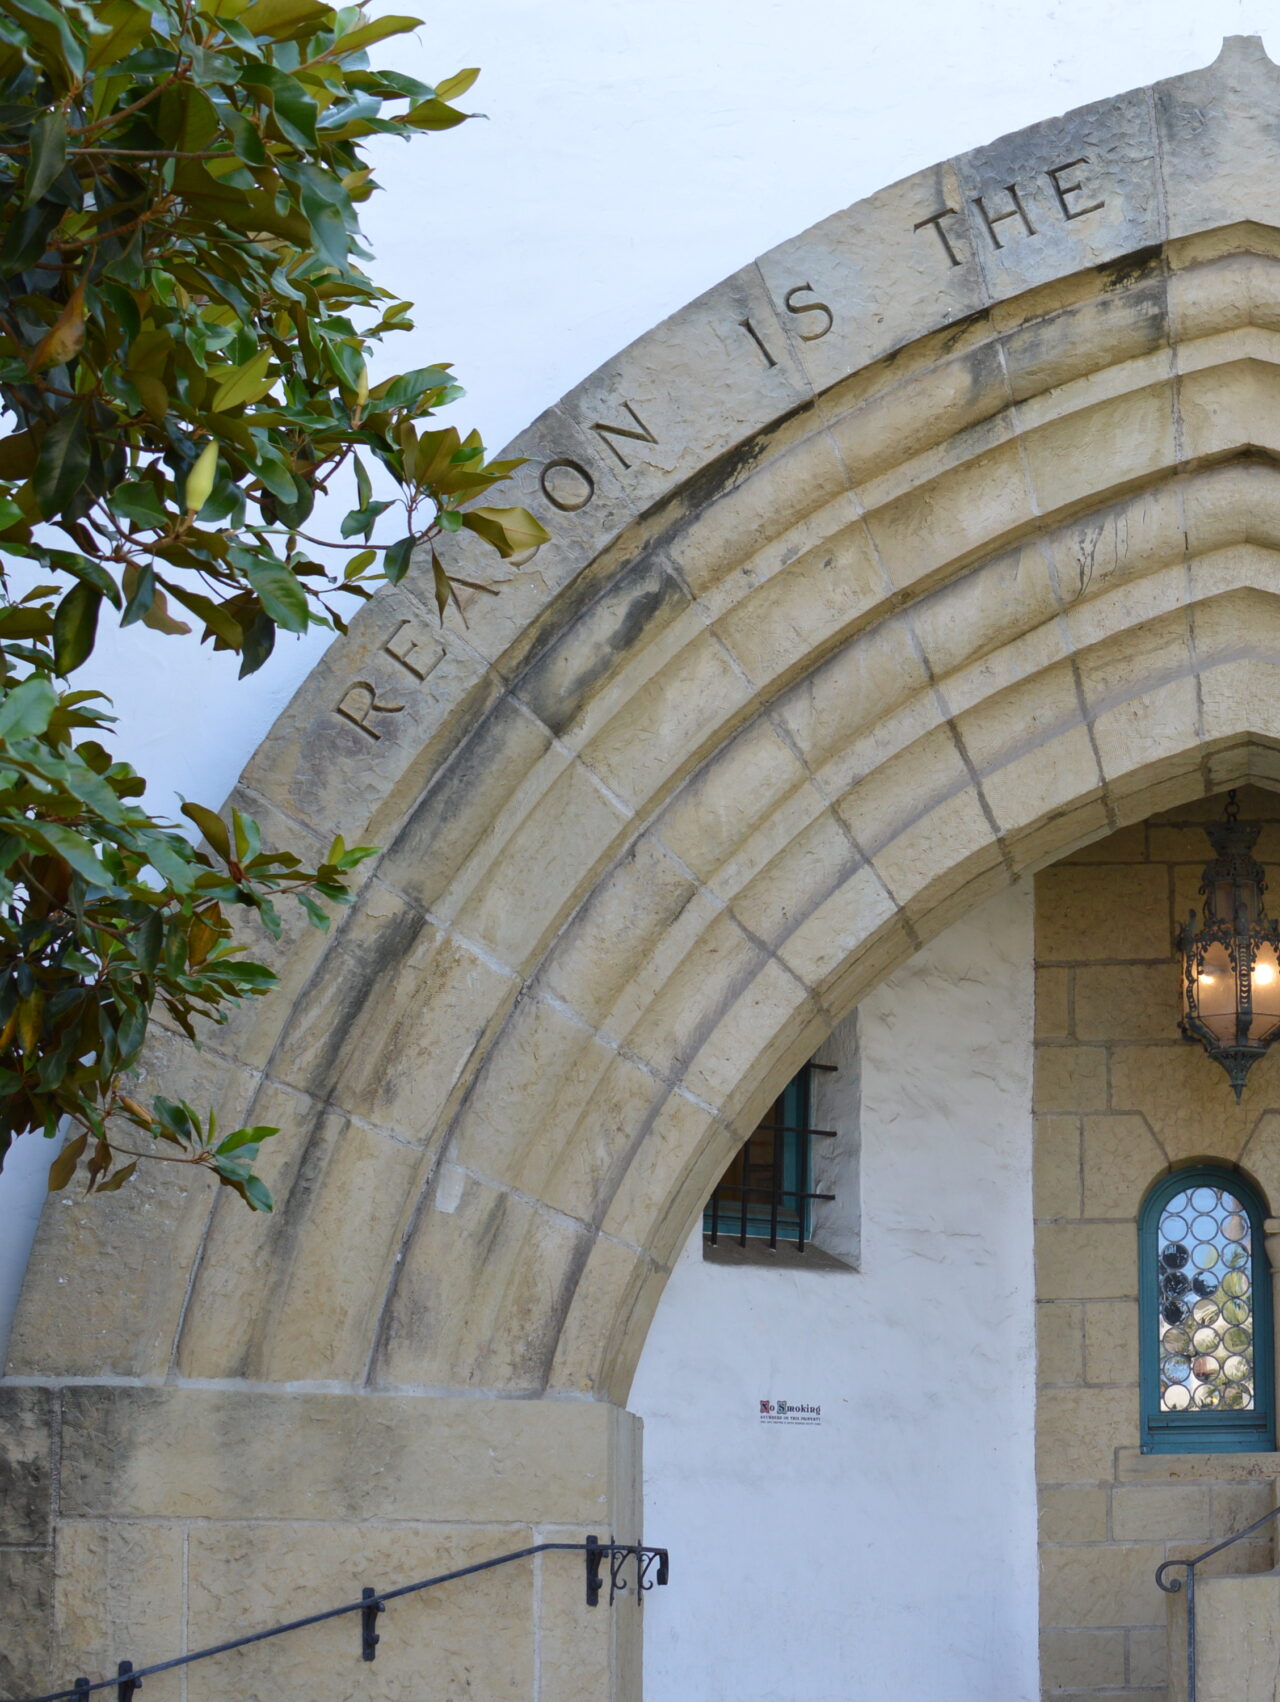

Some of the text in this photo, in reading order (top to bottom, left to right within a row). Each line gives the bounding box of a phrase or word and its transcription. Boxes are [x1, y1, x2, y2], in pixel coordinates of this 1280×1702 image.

[333, 400, 660, 741] REAON
[739, 281, 834, 369] IS
[912, 157, 1106, 267] THE
[760, 1400, 821, 1415] No Smoking
